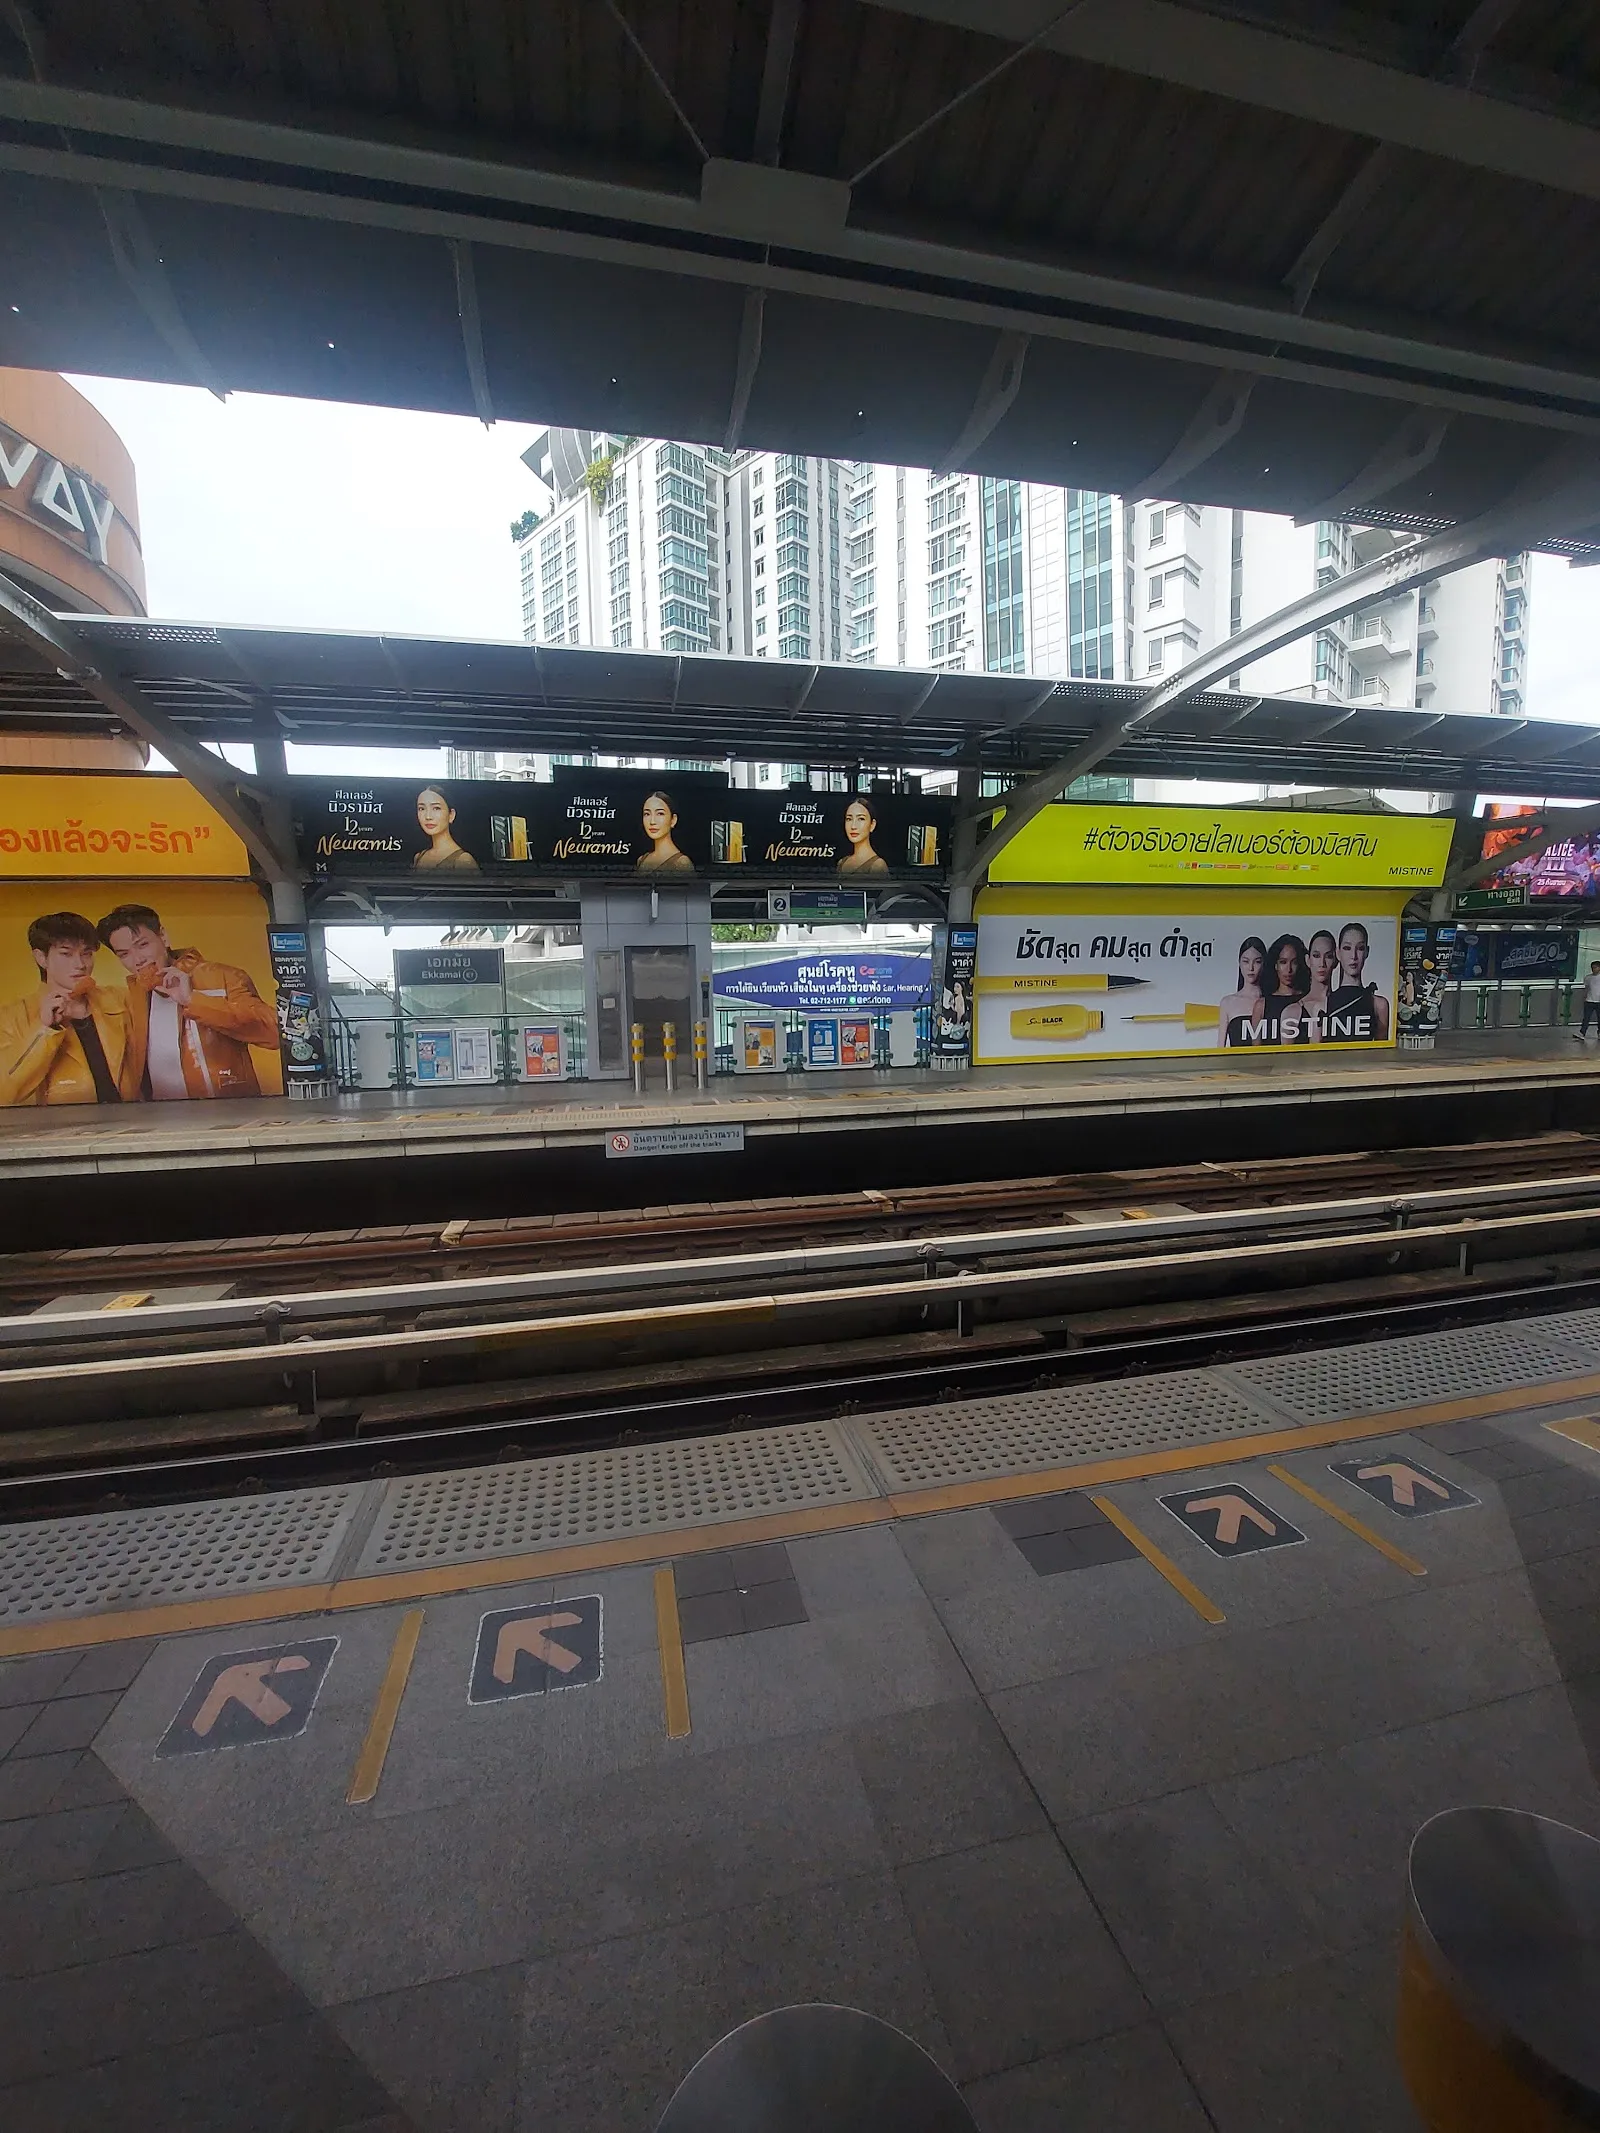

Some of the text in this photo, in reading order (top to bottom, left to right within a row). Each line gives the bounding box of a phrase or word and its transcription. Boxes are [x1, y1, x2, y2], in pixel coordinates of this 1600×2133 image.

[328, 800, 384, 813] นิวรามิส
[566, 806, 616, 819] นิวรามิส
[779, 812, 824, 824] นิวรามิส
[344, 816, 358, 836] 12
[579, 821, 592, 839] 12
[789, 826, 801, 843] 12
[316, 832, 401, 856] Neuramis
[553, 837, 630, 859] Neuramis
[1544, 843, 1575, 857] ALICE
[765, 841, 834, 861] Neuramis
[1388, 867, 1434, 875] MISTINE
[1487, 889, 1521, 899] ทางออก
[1506, 896, 1521, 904] Exit
[776, 899, 784, 910] 2
[1016, 928, 1080, 964] ชัดสุด
[1089, 935, 1151, 963] คมสุด
[427, 952, 471, 967] เอกมัย
[276, 962, 306, 975] งาดำ
[421, 970, 461, 979] Ekkamai
[897, 984, 923, 993] Hearing
[1014, 979, 1058, 987] MISTINE
[810, 996, 847, 1004] 02-712-1177
[1241, 1015, 1371, 1041] MISTINE
